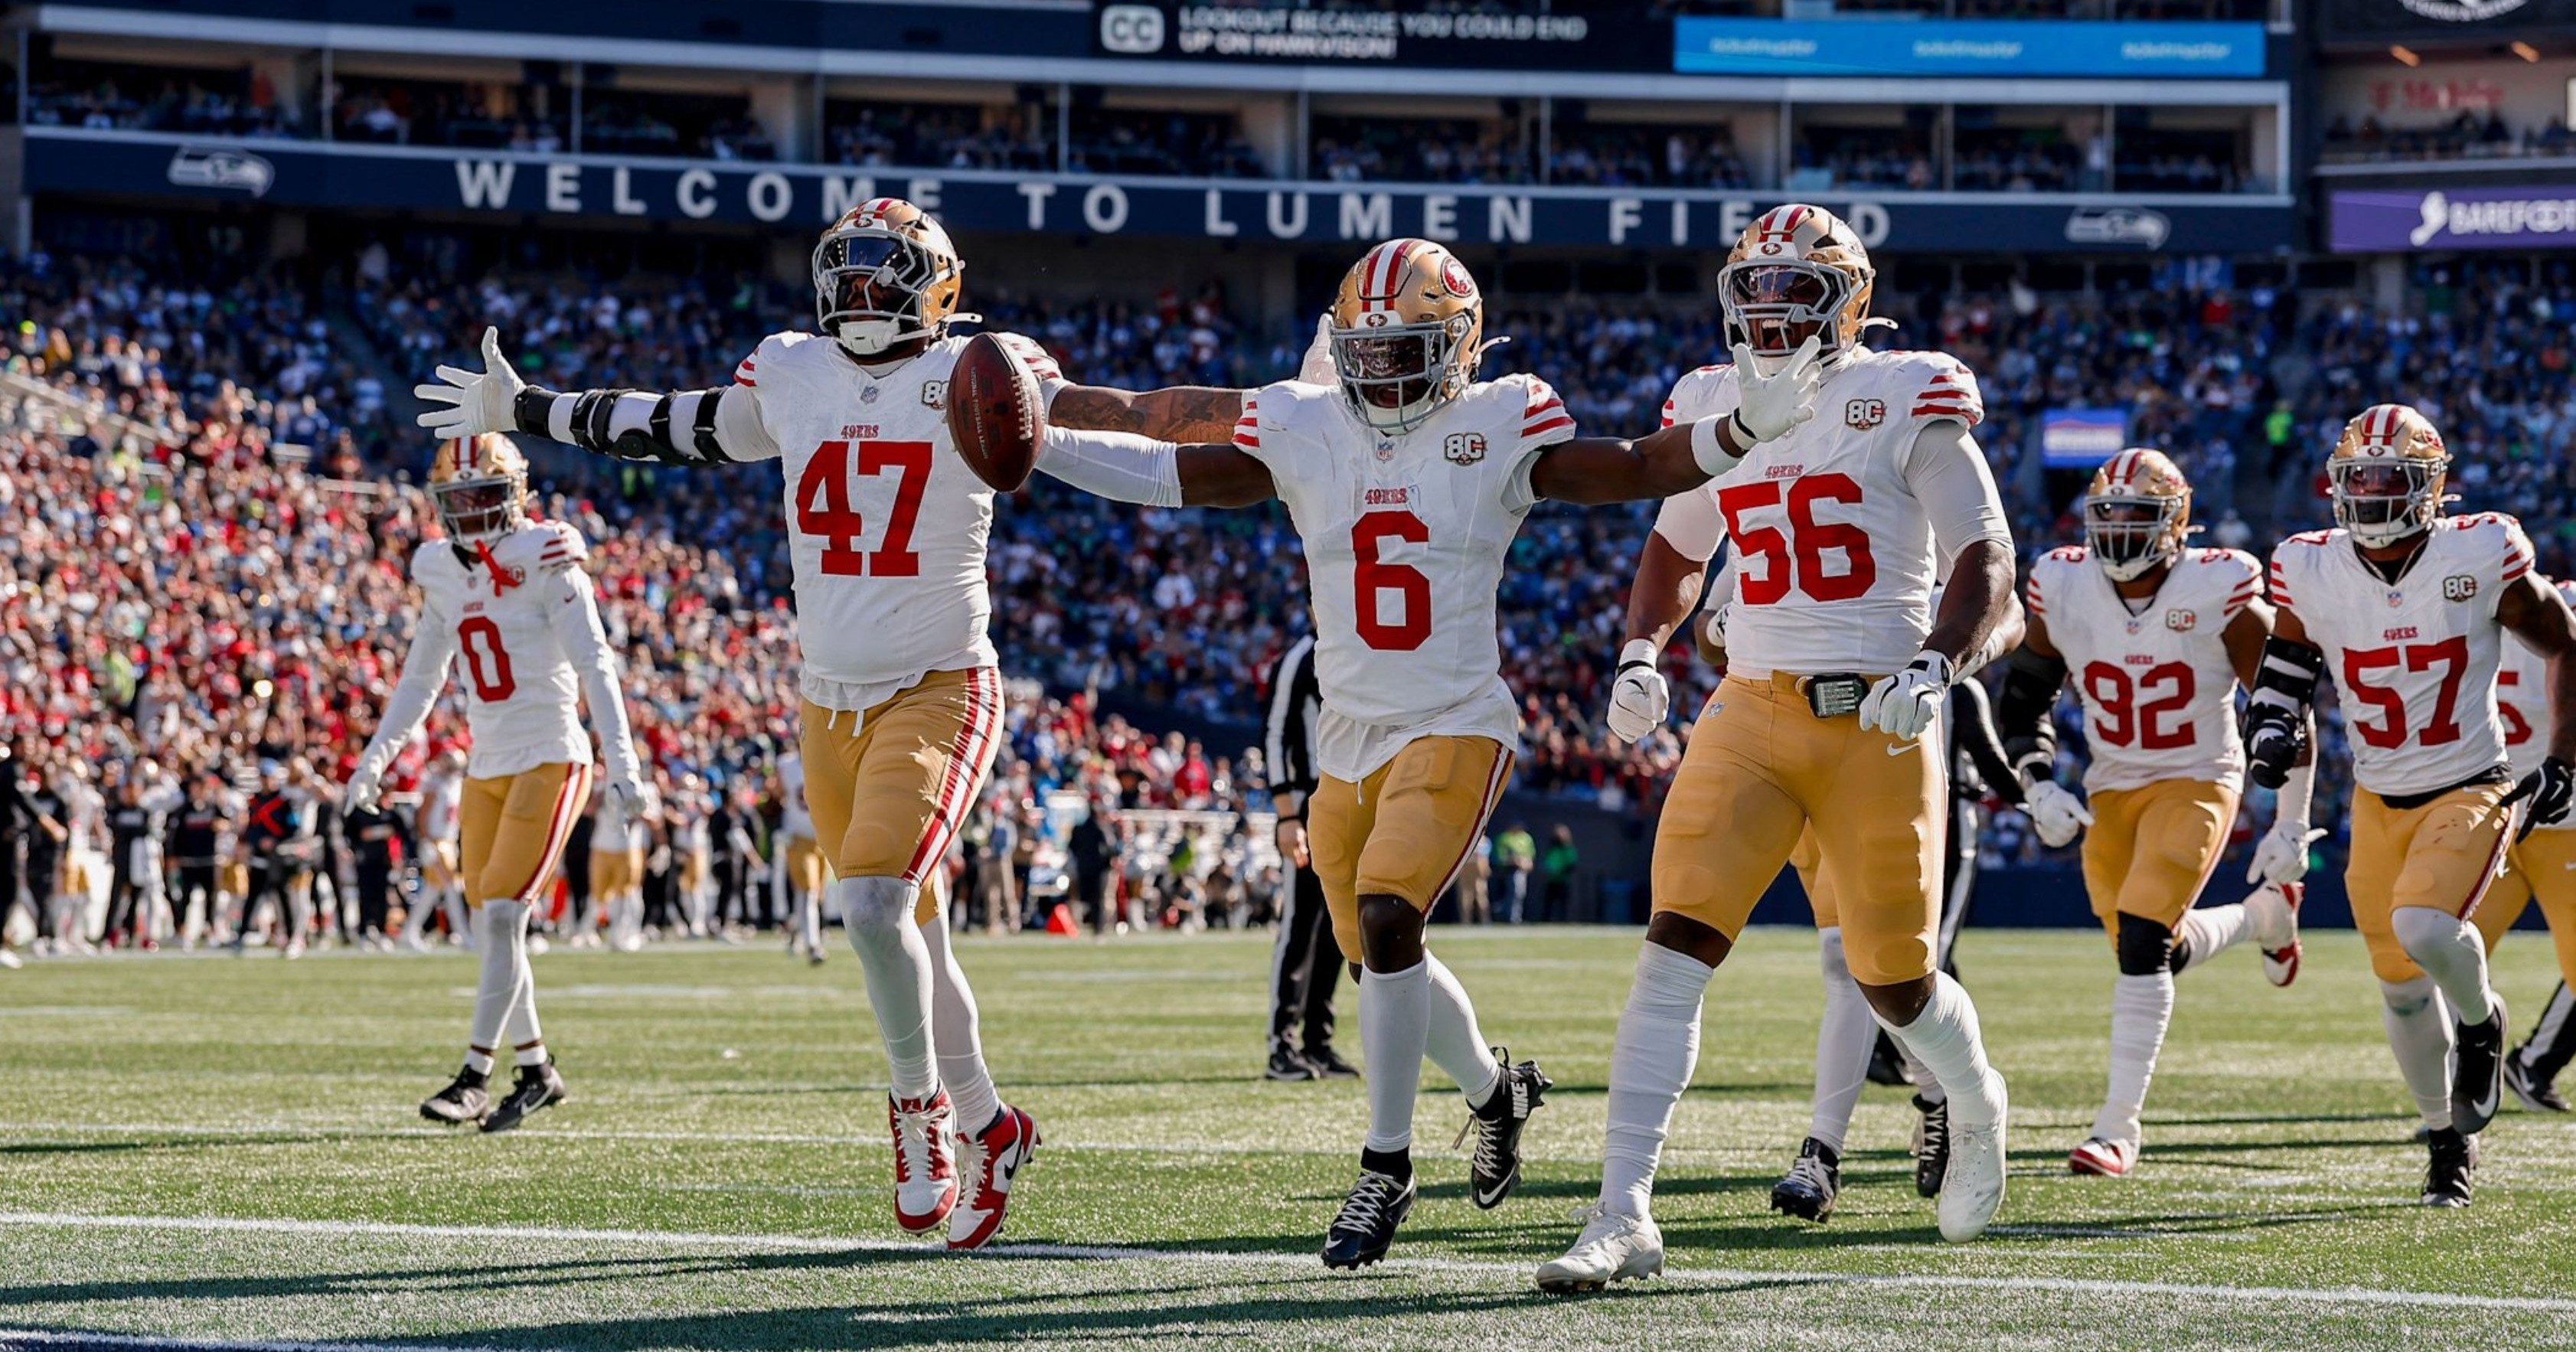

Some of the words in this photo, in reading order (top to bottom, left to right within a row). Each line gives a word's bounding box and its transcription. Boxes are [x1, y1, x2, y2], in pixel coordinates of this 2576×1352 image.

[1179, 6, 1287, 32] LOOKOUT
[1291, 10, 1396, 36] BECAUSE
[1401, 13, 1453, 38] YOU
[1455, 14, 1535, 40] COULD
[1536, 15, 1588, 41] END
[1179, 31, 1213, 53] UP
[1215, 31, 1252, 54] ON
[1018, 182, 1130, 233] TO
[1204, 188, 1533, 242] LUMEN
[1608, 199, 1890, 247] FIED
[841, 425, 879, 439] 49ERS
[795, 441, 933, 576] 47
[1717, 472, 1876, 605] 56
[1352, 511, 1432, 651] 6
[458, 616, 516, 703] 0
[2383, 626, 2418, 642] 49ERS
[2084, 660, 2196, 749] 92
[2342, 635, 2469, 749] 57
[1511, 1082, 1528, 1119] NIKE
